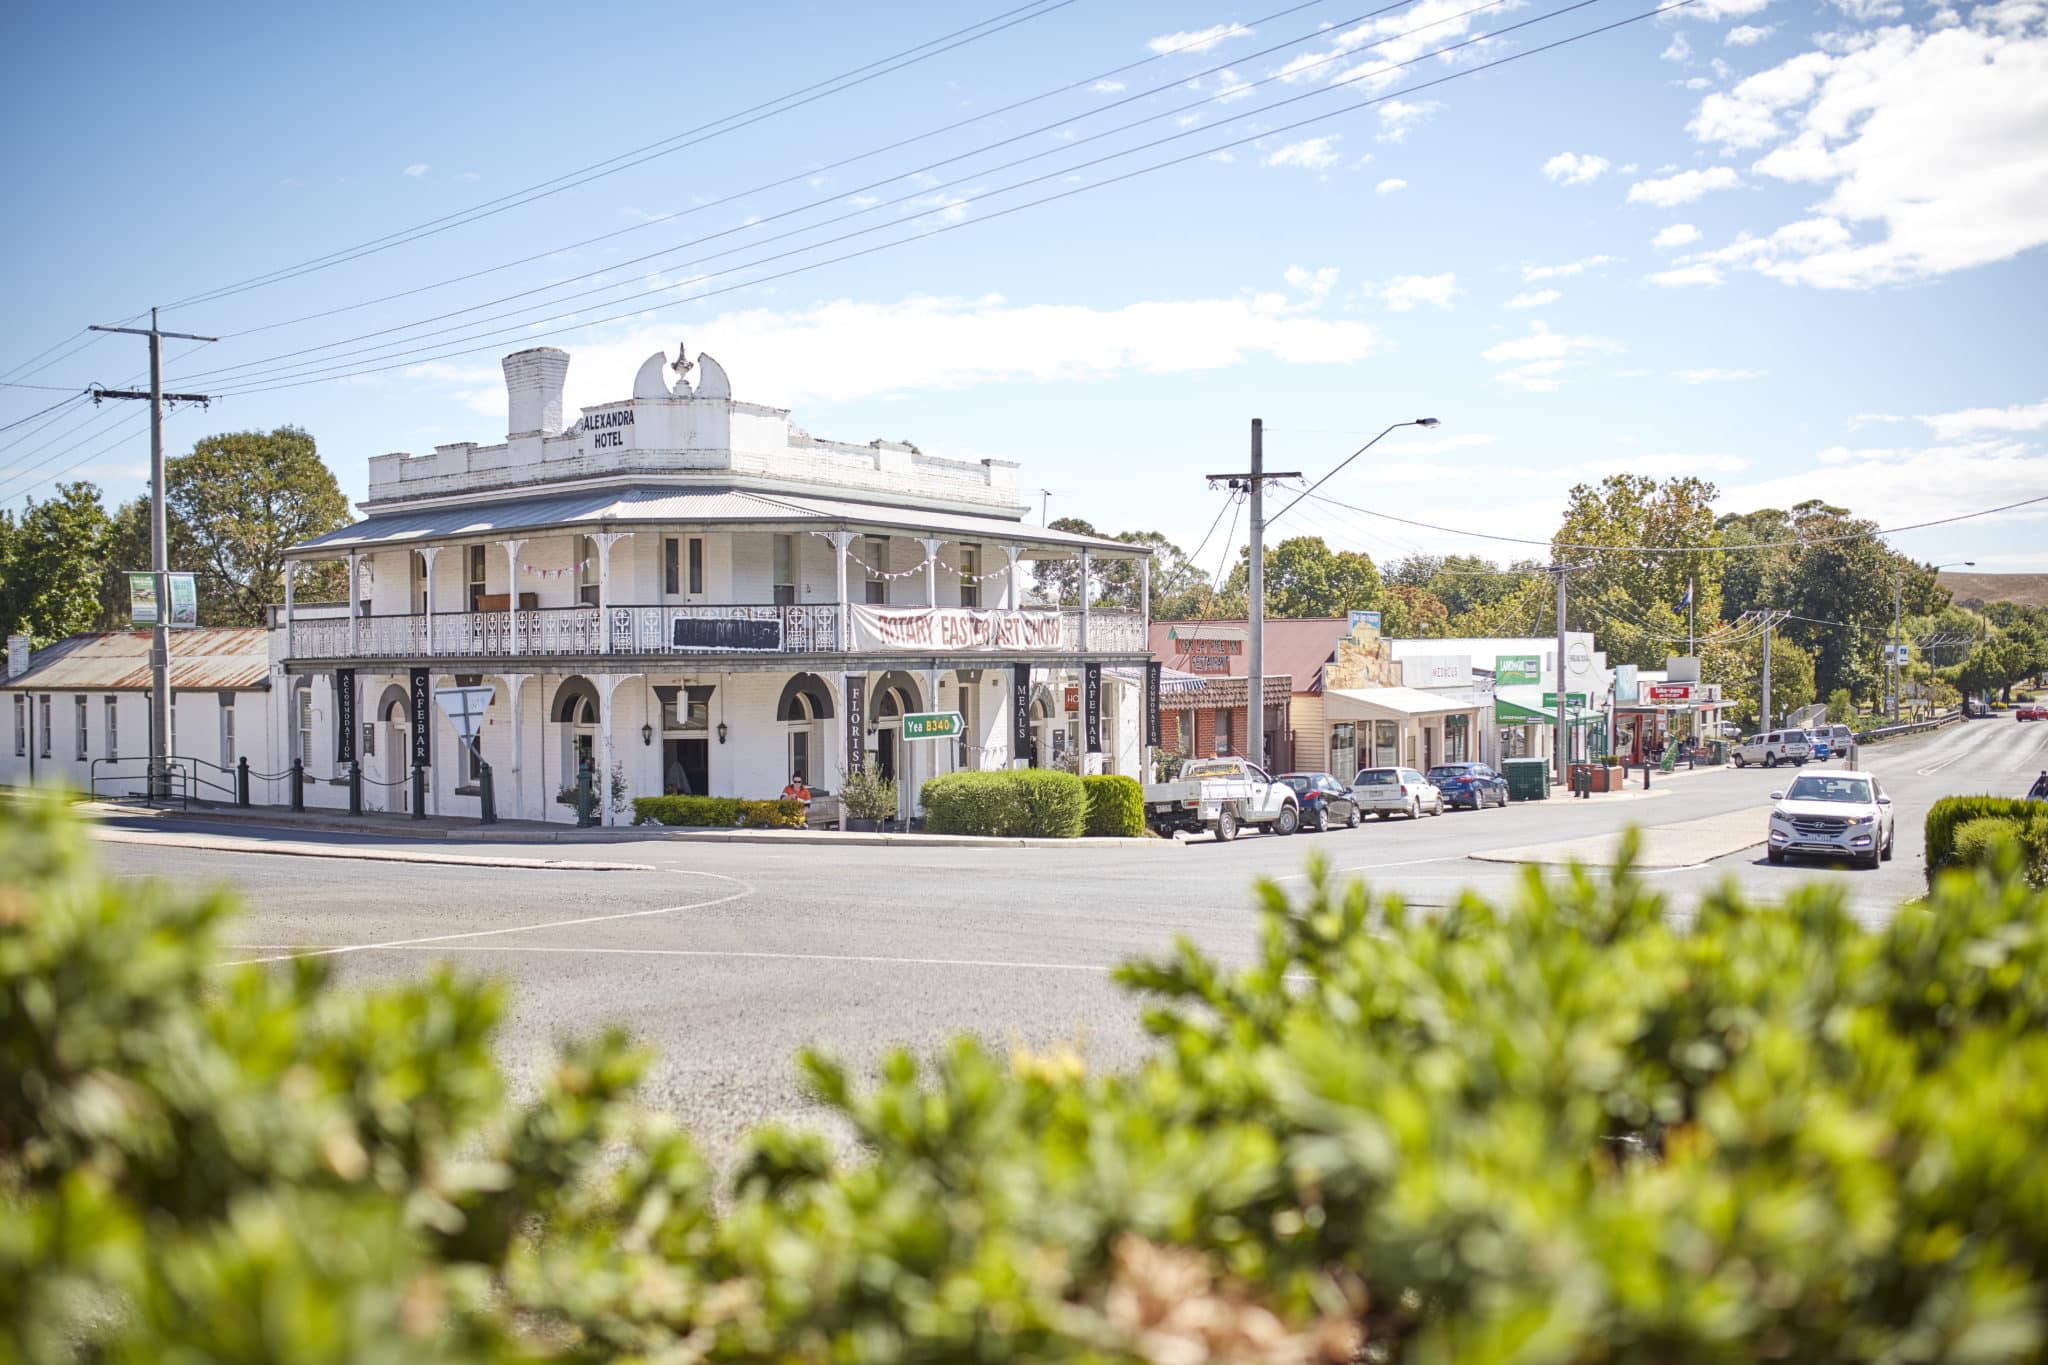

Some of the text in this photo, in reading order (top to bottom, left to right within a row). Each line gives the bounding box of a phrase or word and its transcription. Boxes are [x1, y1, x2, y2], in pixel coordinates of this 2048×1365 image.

[584, 409, 635, 431] ALEXANDRA
[594, 431, 623, 449] HOTEL
[877, 615, 1061, 647] ROTARY EASTER ART SHOW
[415, 676, 425, 757] CAFE-BAR
[907, 719, 950, 733] Yea B340
[1017, 685, 1026, 738] MEALS
[1088, 669, 1097, 745] CAFE-BAR
[851, 688, 861, 774] FLORIST
